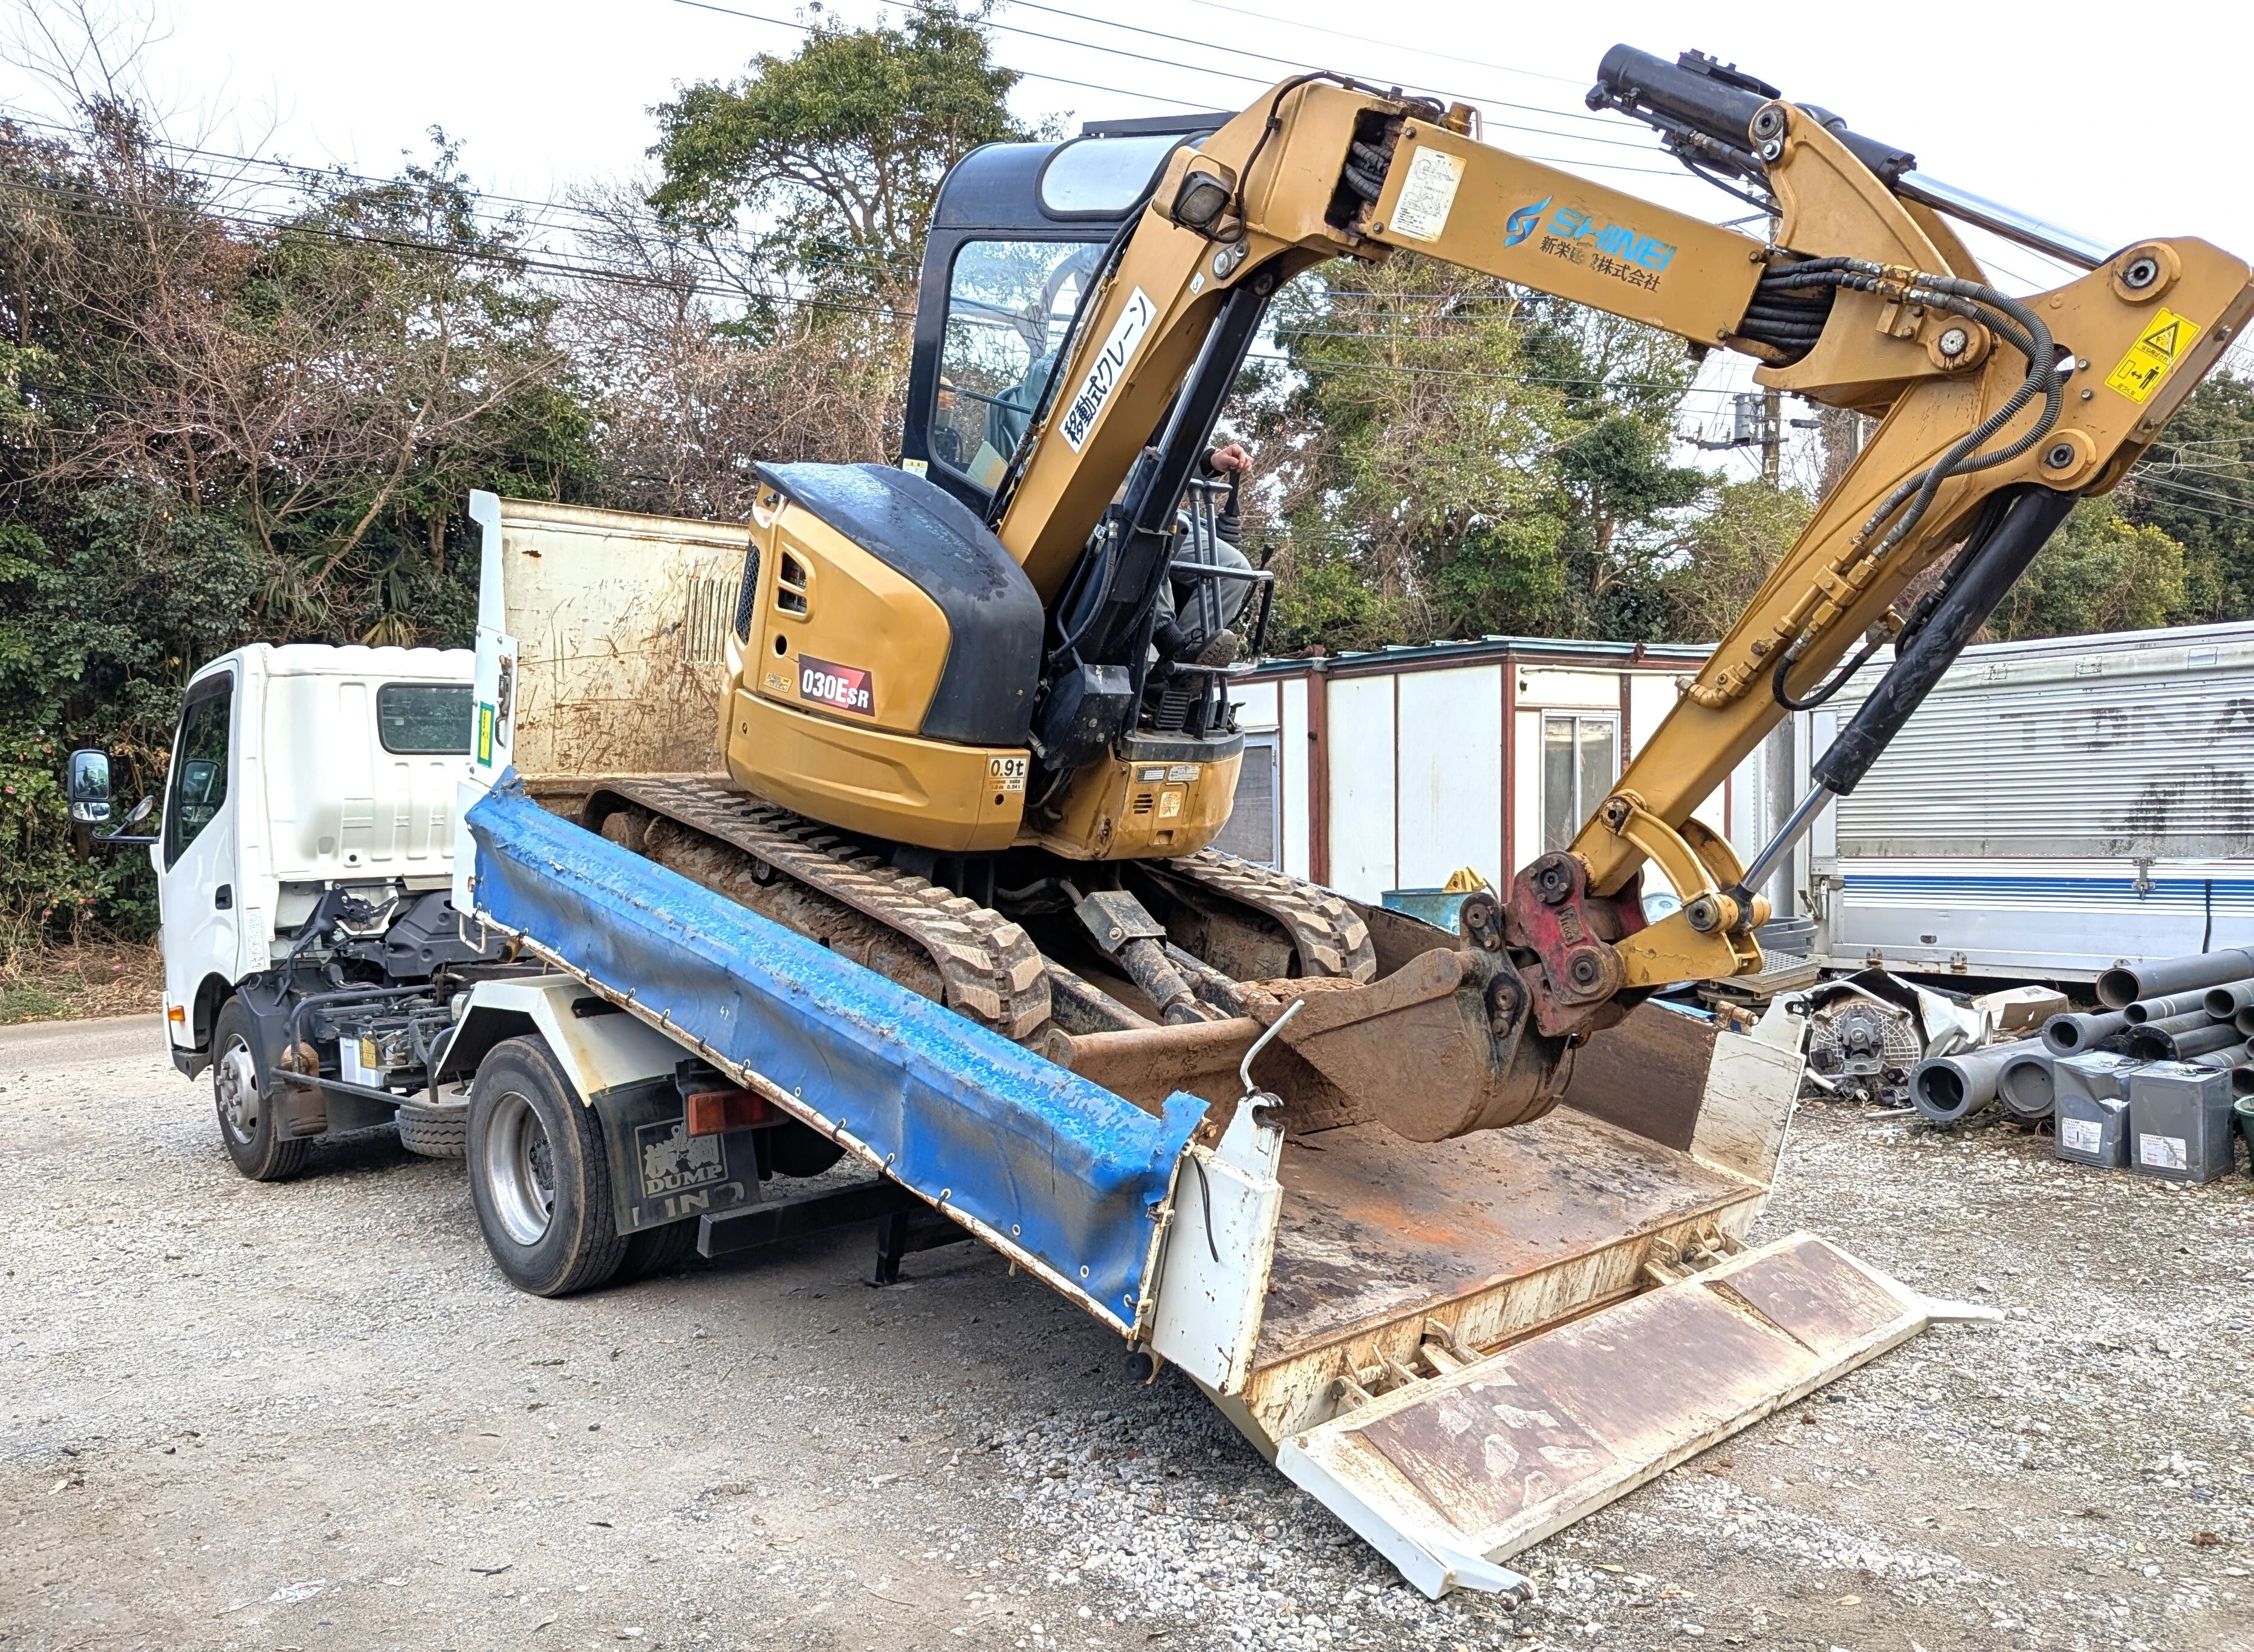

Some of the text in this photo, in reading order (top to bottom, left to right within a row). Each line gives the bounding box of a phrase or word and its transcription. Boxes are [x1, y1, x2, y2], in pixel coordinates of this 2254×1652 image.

[1547, 207, 1678, 272] SHINEI
[2141, 344, 2169, 363] はね飛ばされ
[1064, 295, 1148, 446] 移動式クレーン
[2117, 382, 2136, 396] 近づくな
[646, 1164, 723, 1195] DUMP
